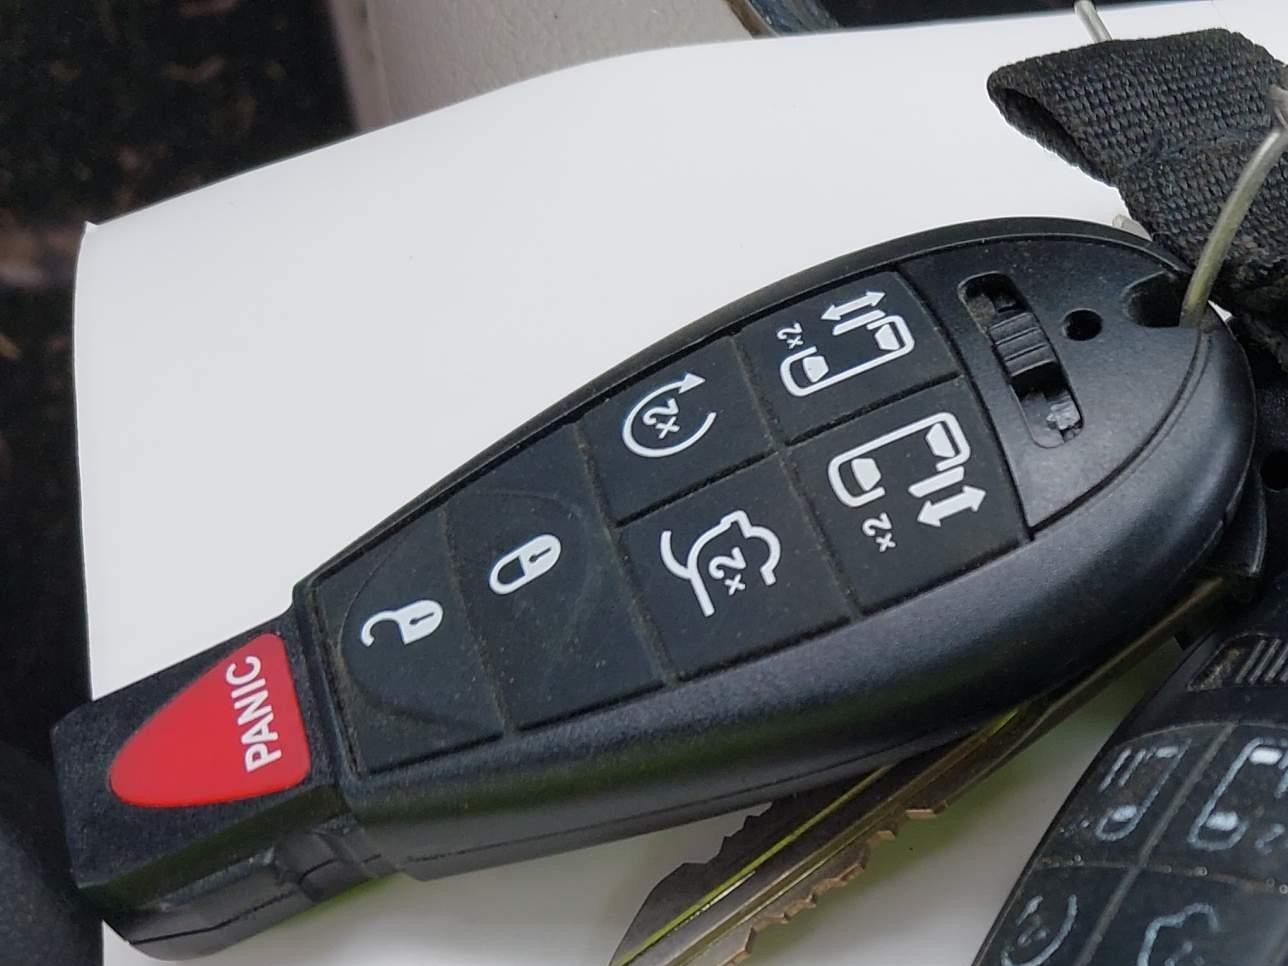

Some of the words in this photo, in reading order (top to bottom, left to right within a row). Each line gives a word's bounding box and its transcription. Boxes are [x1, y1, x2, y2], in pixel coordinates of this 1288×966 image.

[777, 323, 803, 348] x2
[642, 397, 680, 439] x2
[862, 513, 896, 552] x2
[709, 545, 747, 596] x2
[226, 656, 282, 772] PANIC
